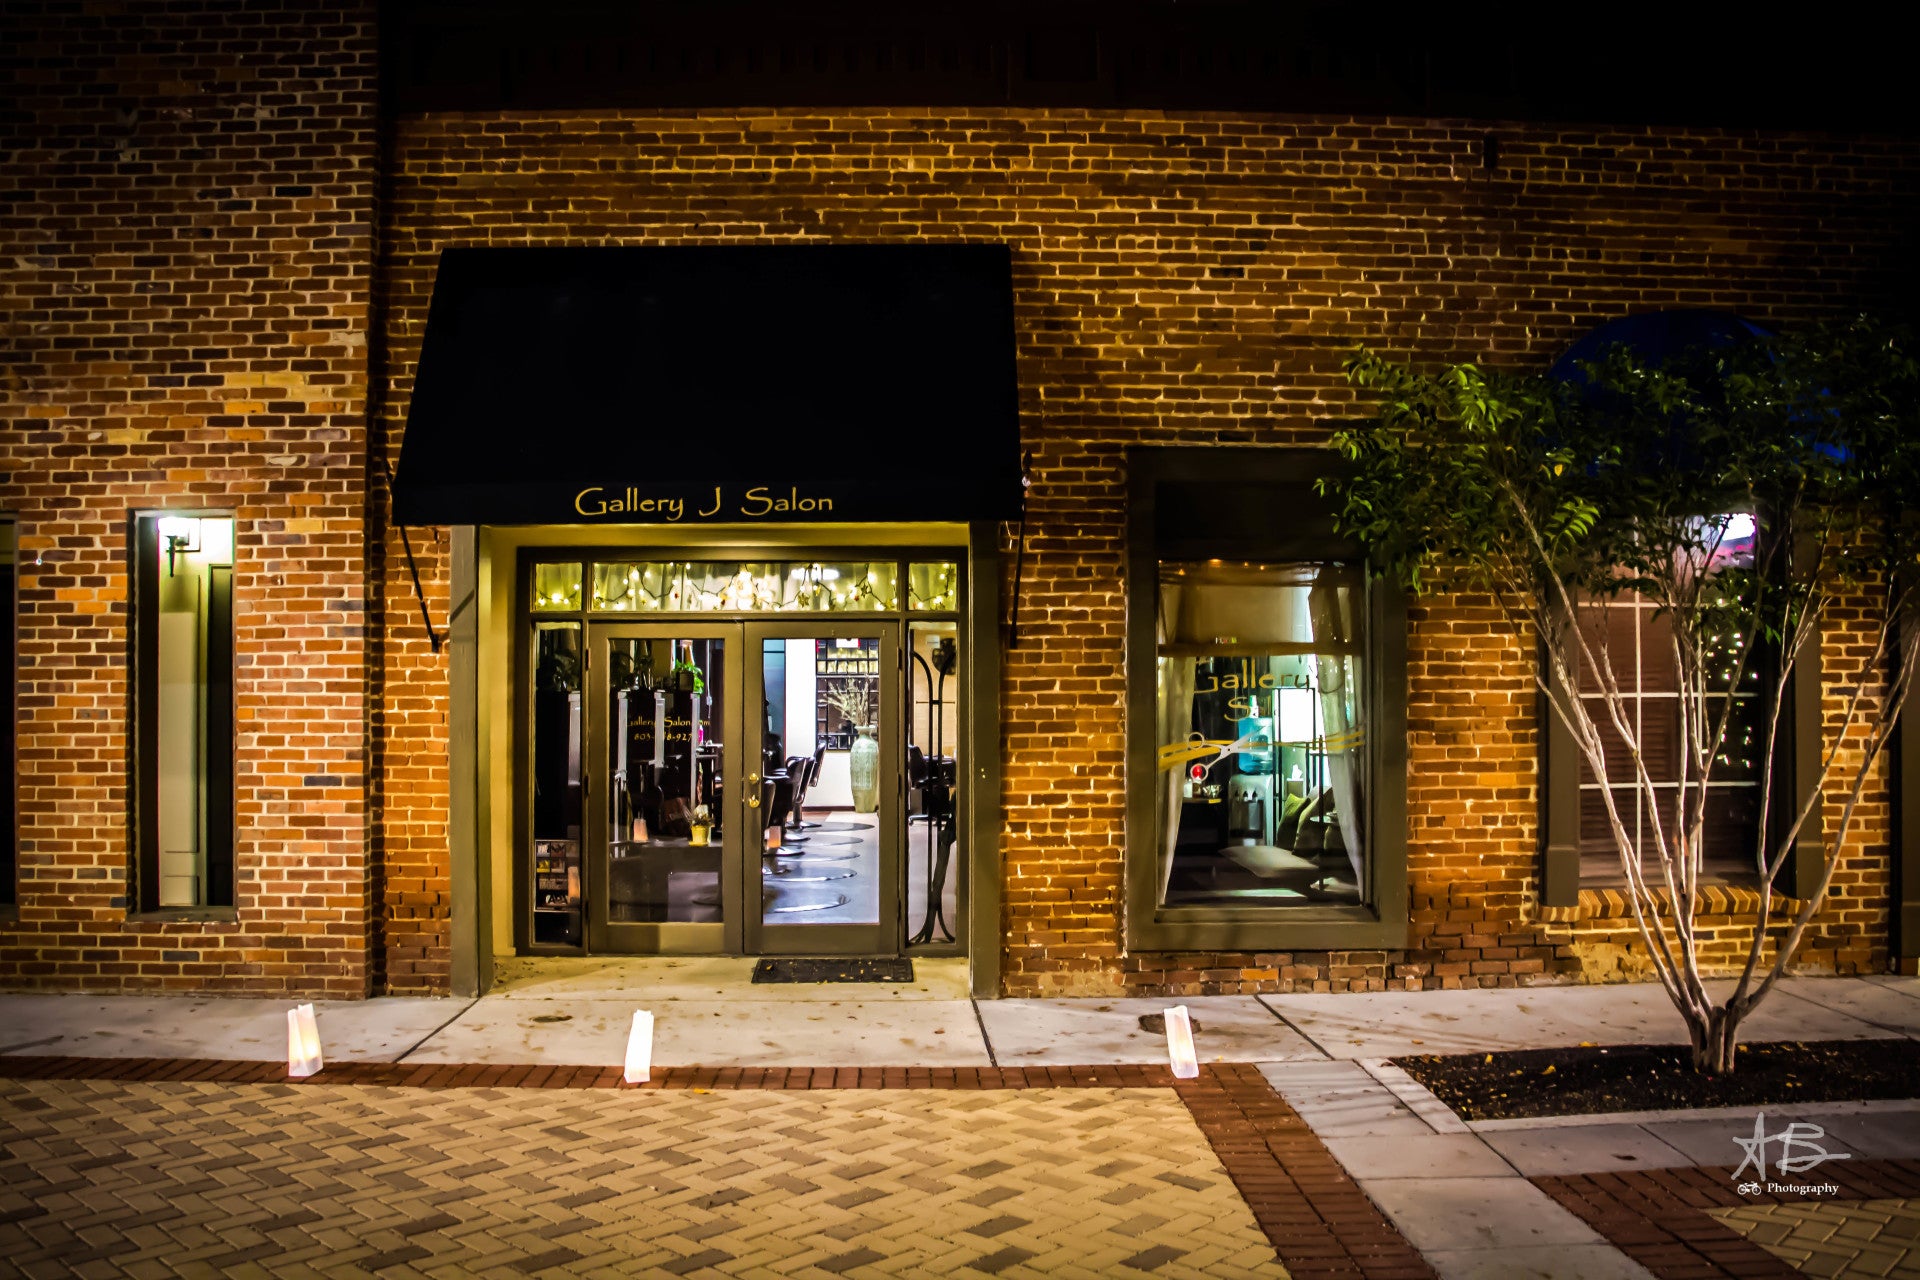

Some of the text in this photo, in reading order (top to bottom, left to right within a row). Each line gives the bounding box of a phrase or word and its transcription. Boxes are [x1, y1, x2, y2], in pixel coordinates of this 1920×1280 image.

[574, 486, 833, 521] Gallery J Salon
